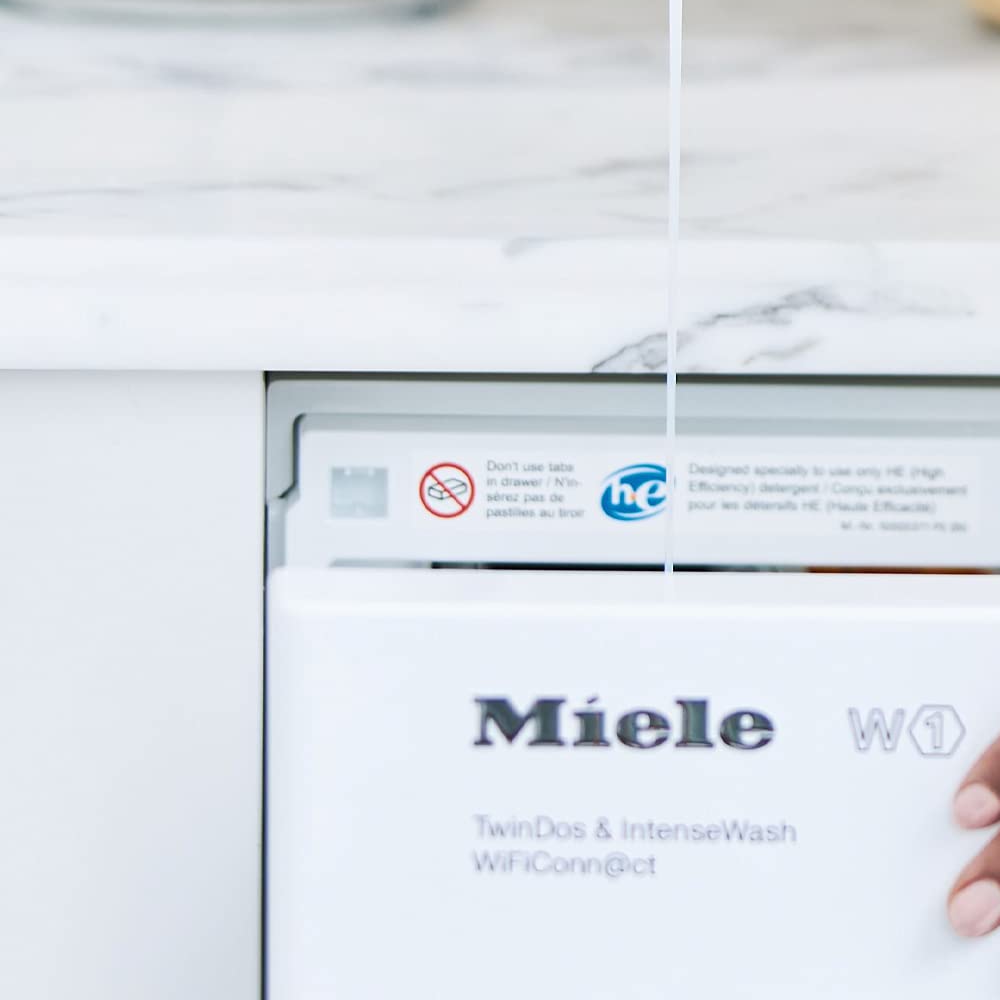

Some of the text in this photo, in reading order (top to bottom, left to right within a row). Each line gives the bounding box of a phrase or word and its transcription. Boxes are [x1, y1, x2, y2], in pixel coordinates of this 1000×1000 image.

[486, 460, 574, 473] Don't use tabs
[688, 463, 750, 477] Designed
[812, 465, 826, 476] to
[829, 467, 851, 477] use
[886, 466, 905, 477] HE
[486, 476, 498, 487] in
[501, 476, 543, 488] drawer
[759, 482, 820, 496] detergent
[523, 493, 545, 505] pas
[549, 492, 564, 503] de
[486, 507, 535, 519] pastilles
[539, 509, 555, 518] au
[472, 695, 776, 751] Miele
[474, 813, 798, 844] TwinDos & IntenseWash
[472, 850, 657, 878] WiFiConn@ct
